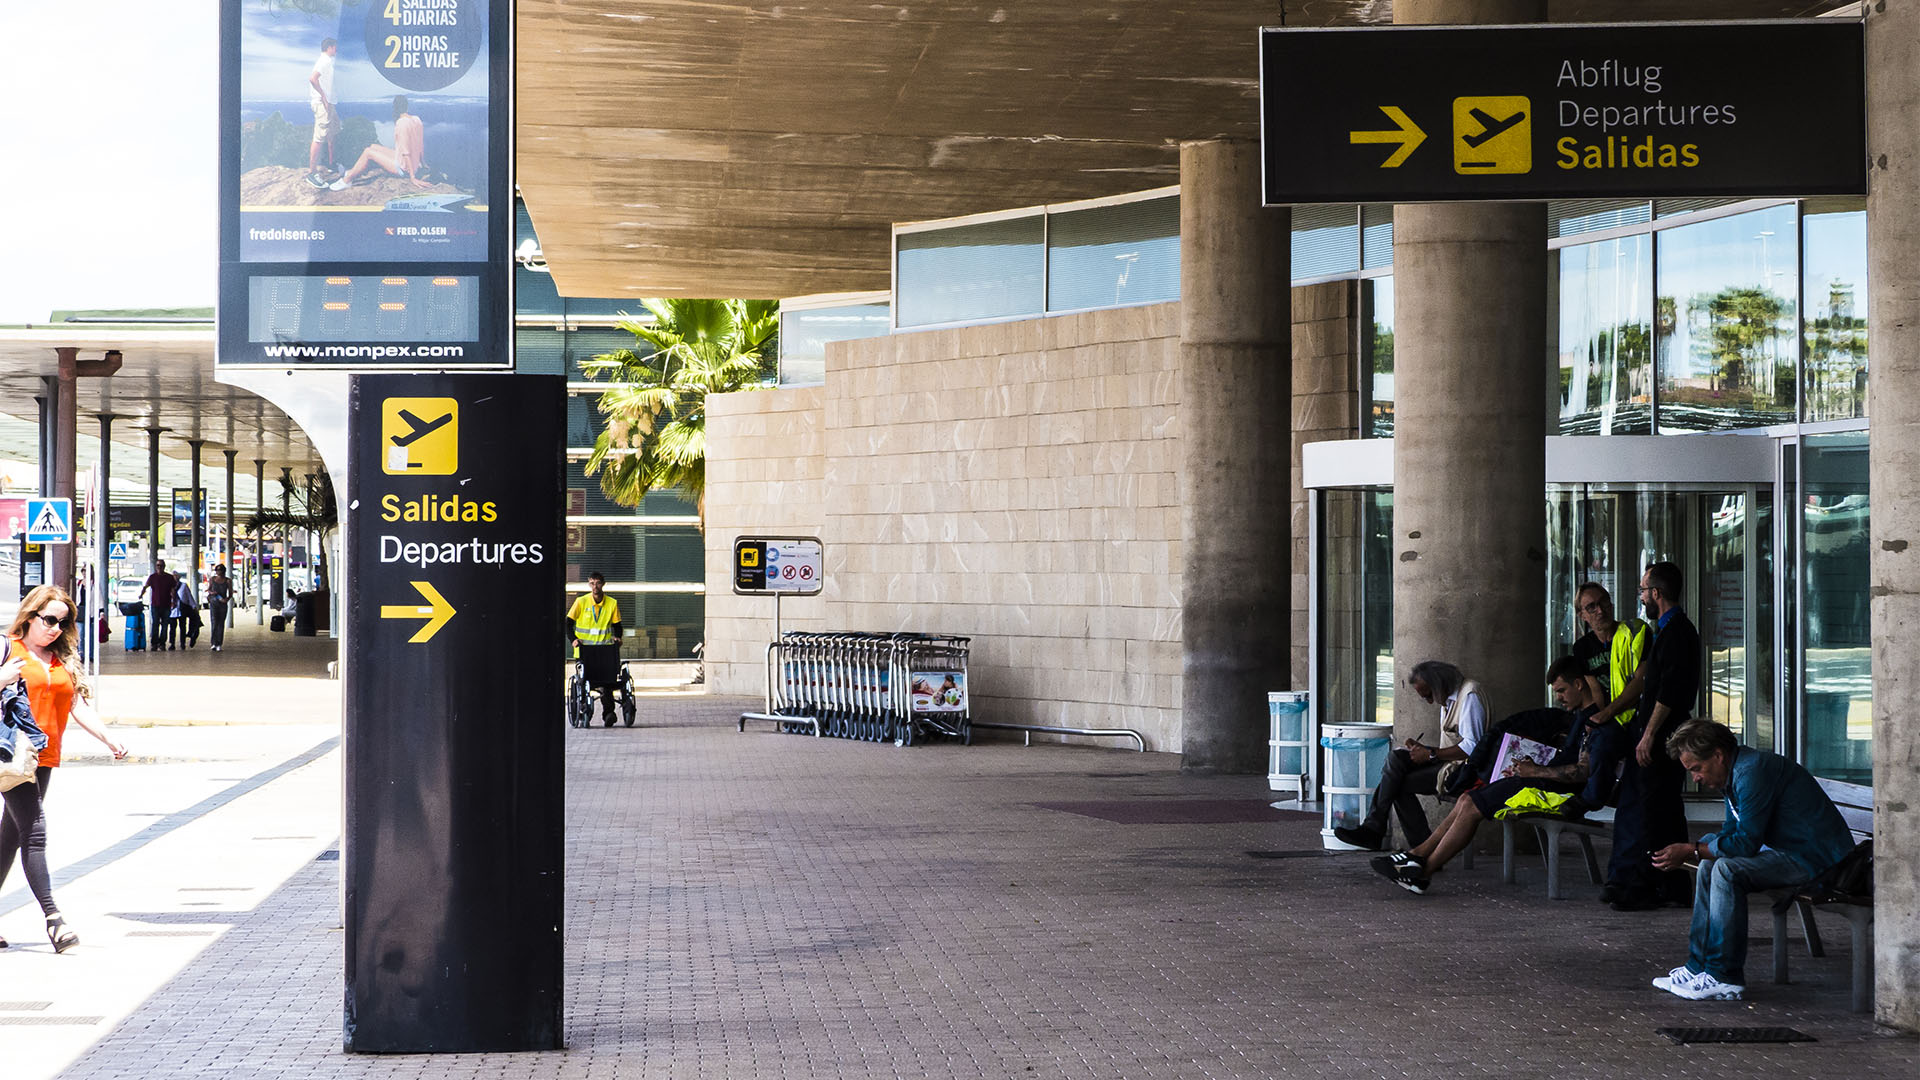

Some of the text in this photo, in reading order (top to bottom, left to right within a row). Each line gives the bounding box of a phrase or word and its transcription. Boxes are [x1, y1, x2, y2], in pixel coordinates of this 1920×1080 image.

[383, 0, 458, 26] 4 SALIDAS
[402, 10, 457, 26] DIARIAS
[384, 35, 448, 68] 2 HORAS
[402, 52, 460, 68] DE VIAJE
[1556, 59, 1662, 93] Abflug
[1558, 99, 1737, 133] Departures
[1556, 135, 1701, 169] Salidas
[249, 228, 326, 240] fredolsen.es
[264, 345, 464, 360] www.monpex.com
[381, 494, 498, 522] Salidas
[380, 535, 544, 568] Departures
